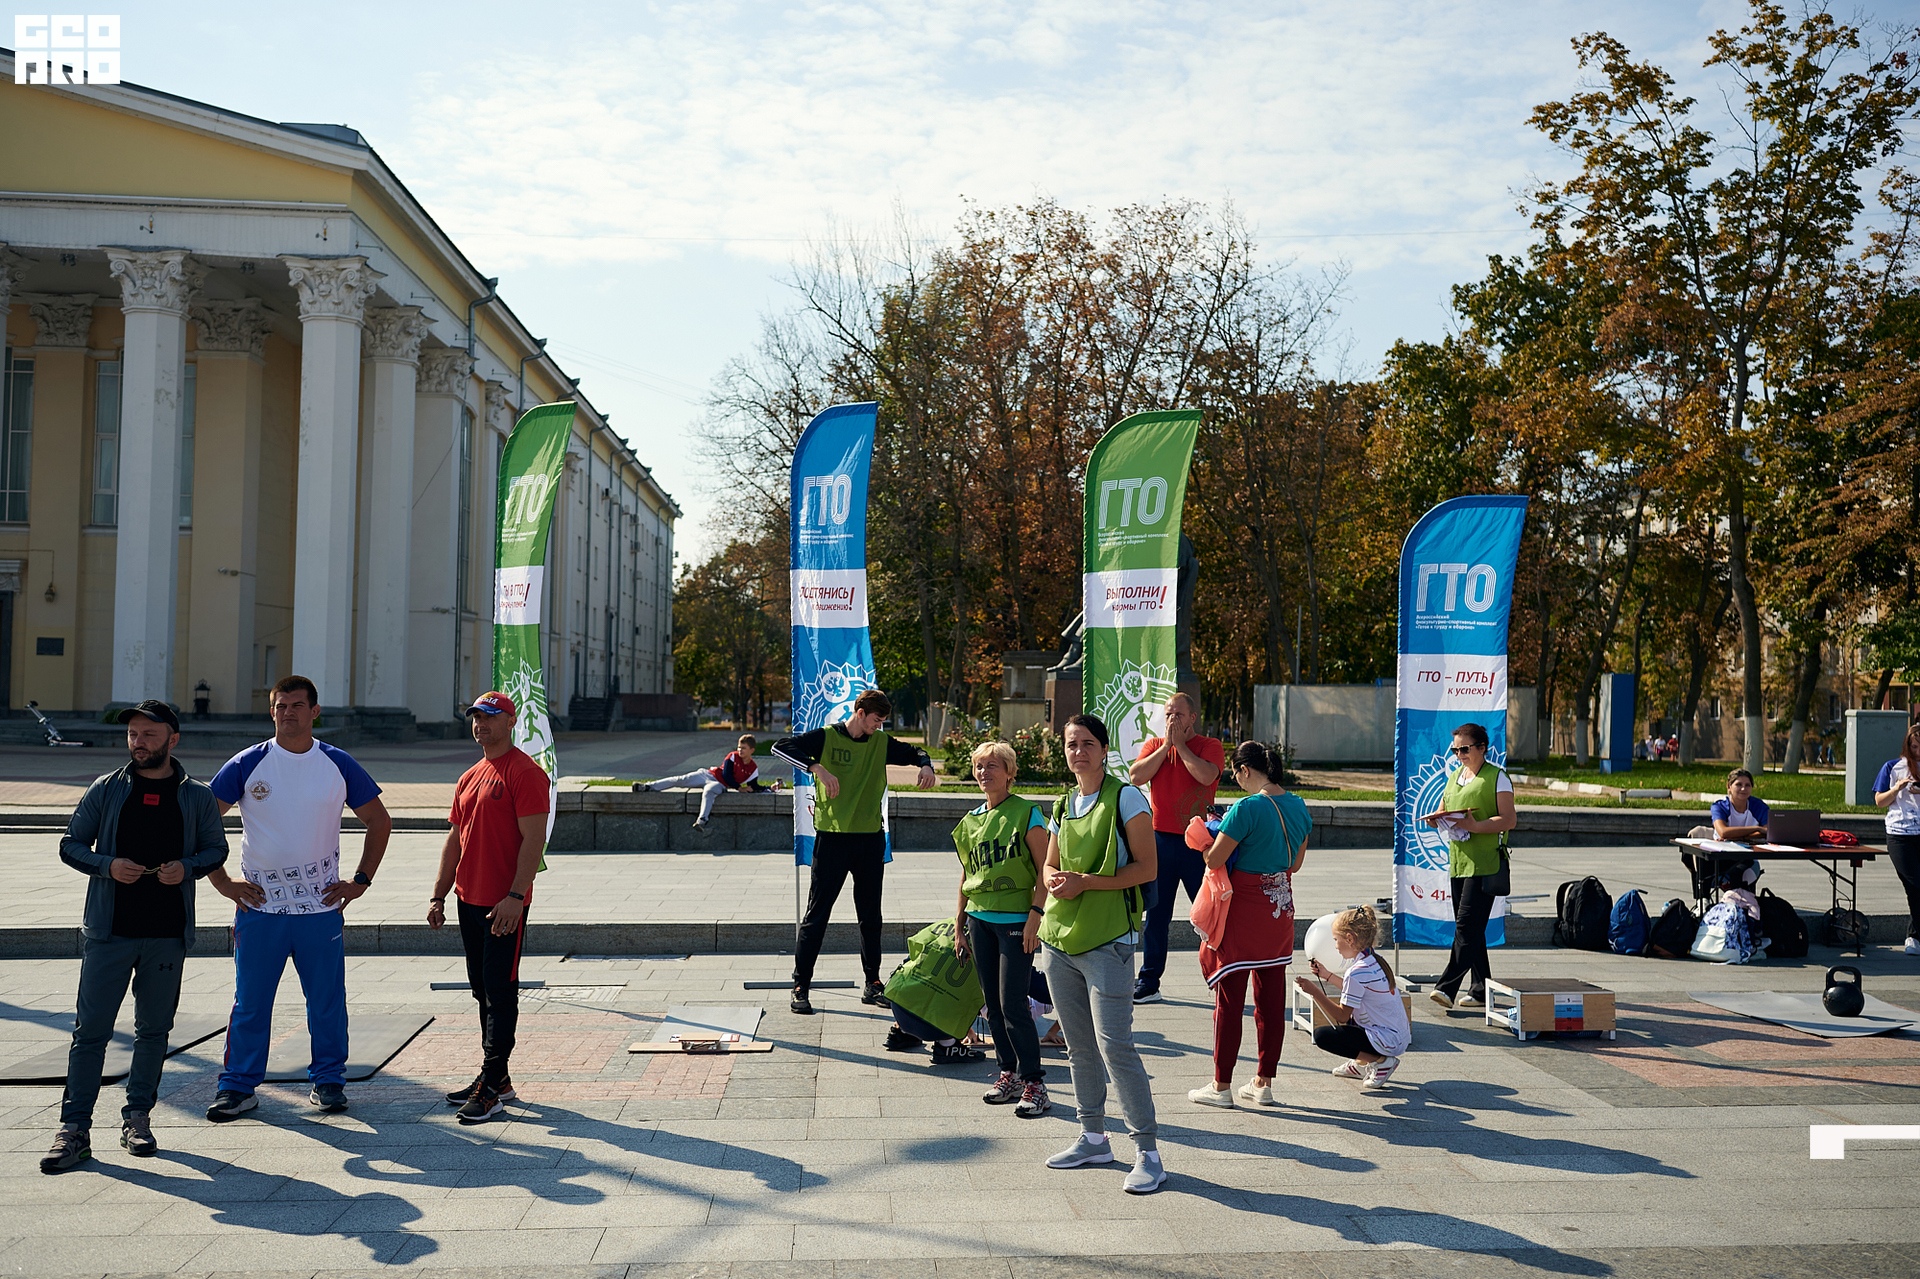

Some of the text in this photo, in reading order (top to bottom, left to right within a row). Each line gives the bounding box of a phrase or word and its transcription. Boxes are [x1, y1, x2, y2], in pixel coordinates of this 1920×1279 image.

[504, 474, 549, 524] ГТО
[800, 474, 852, 526] ГТО
[1098, 476, 1168, 529] ГТО
[1416, 563, 1497, 613] ГТО
[1138, 600, 1157, 611] ГТО
[1417, 670, 1442, 683] ГТО
[1447, 687, 1453, 695] к
[831, 747, 852, 763] ГТО
